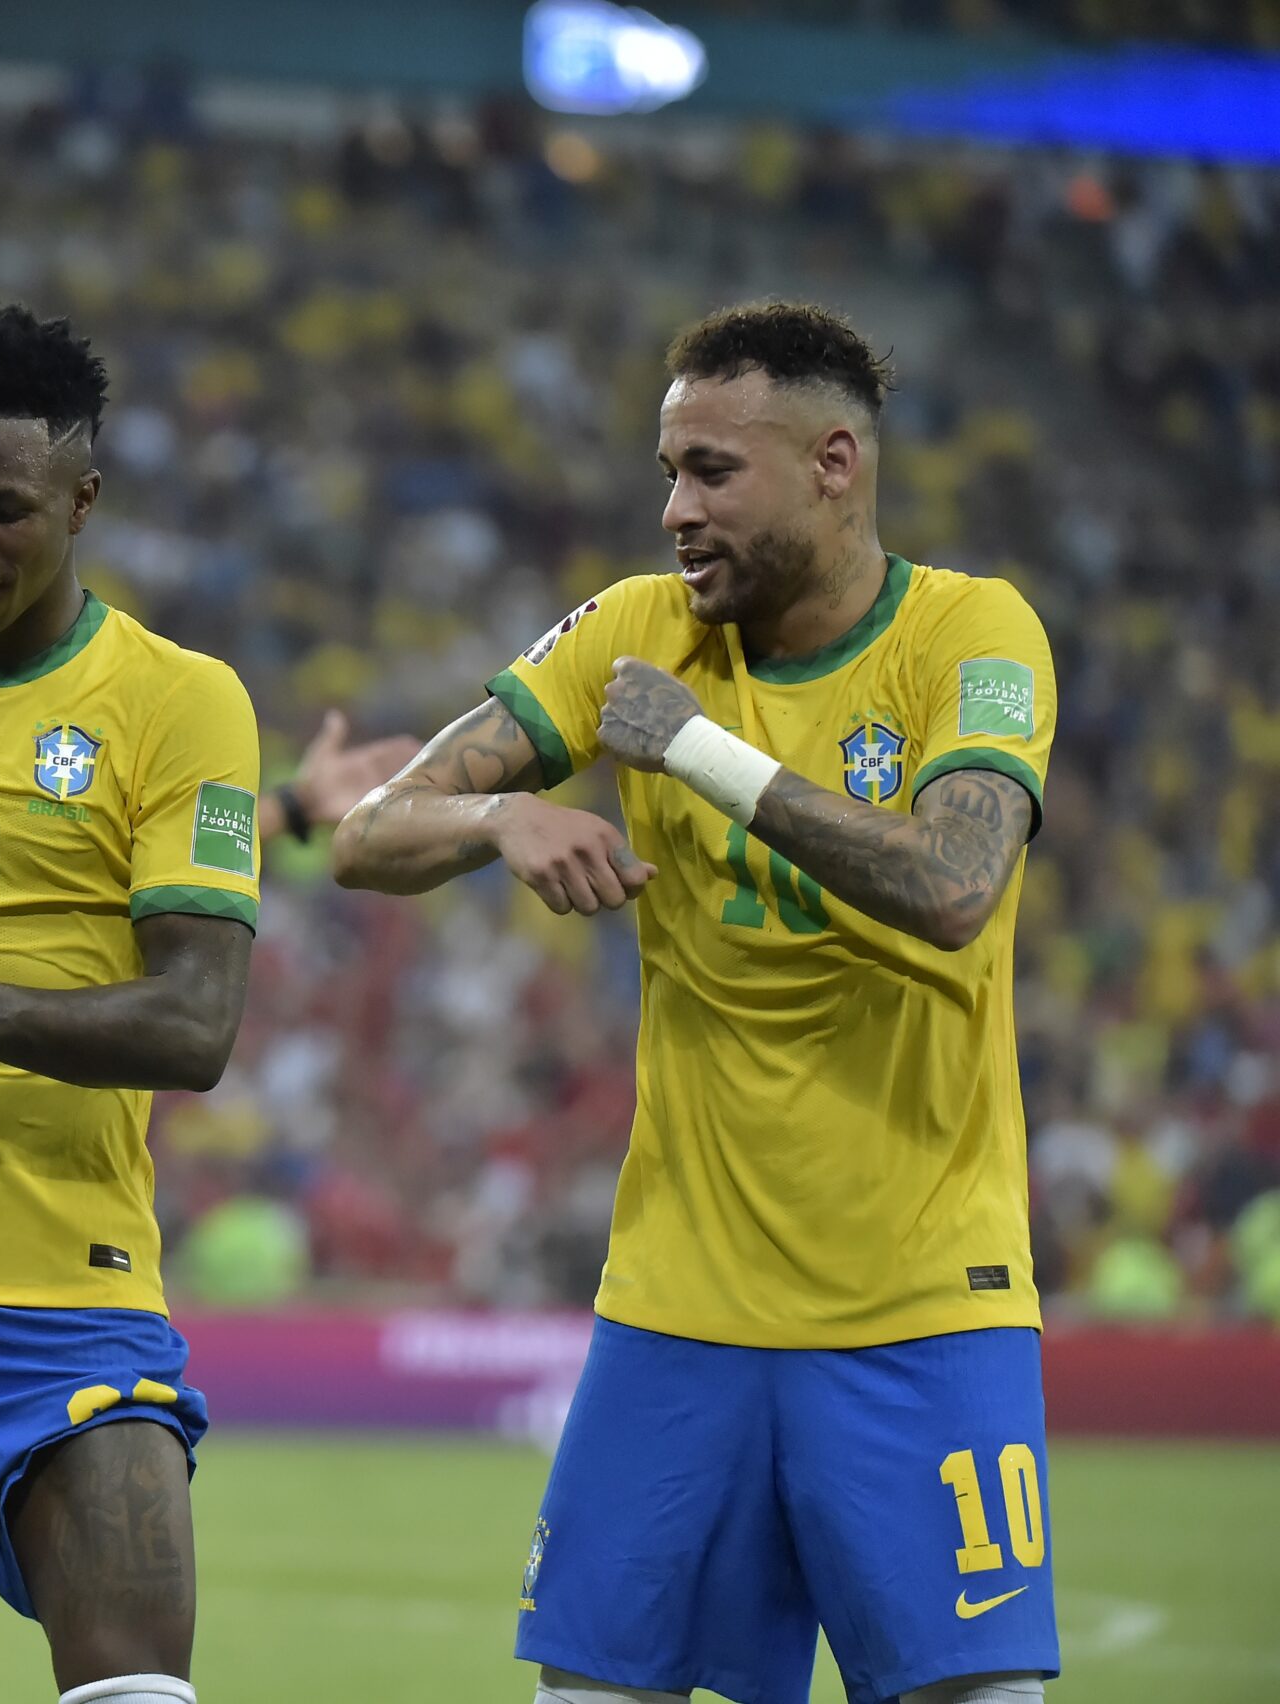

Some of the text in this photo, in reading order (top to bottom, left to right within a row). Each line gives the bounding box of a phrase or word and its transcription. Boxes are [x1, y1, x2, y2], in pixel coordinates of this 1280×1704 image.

[967, 679, 1029, 696] LIVING
[967, 688, 1027, 704] FOOTBALL
[1003, 706, 1027, 724] FIFA
[52, 756, 78, 767] CBF
[860, 757, 885, 768] CBF
[28, 800, 92, 823] BRASIL
[203, 805, 251, 825] LIVING
[201, 815, 251, 835] FOOTBALL
[236, 840, 250, 854] FIFA
[721, 821, 832, 934] 10
[938, 1443, 1045, 1575] 10
